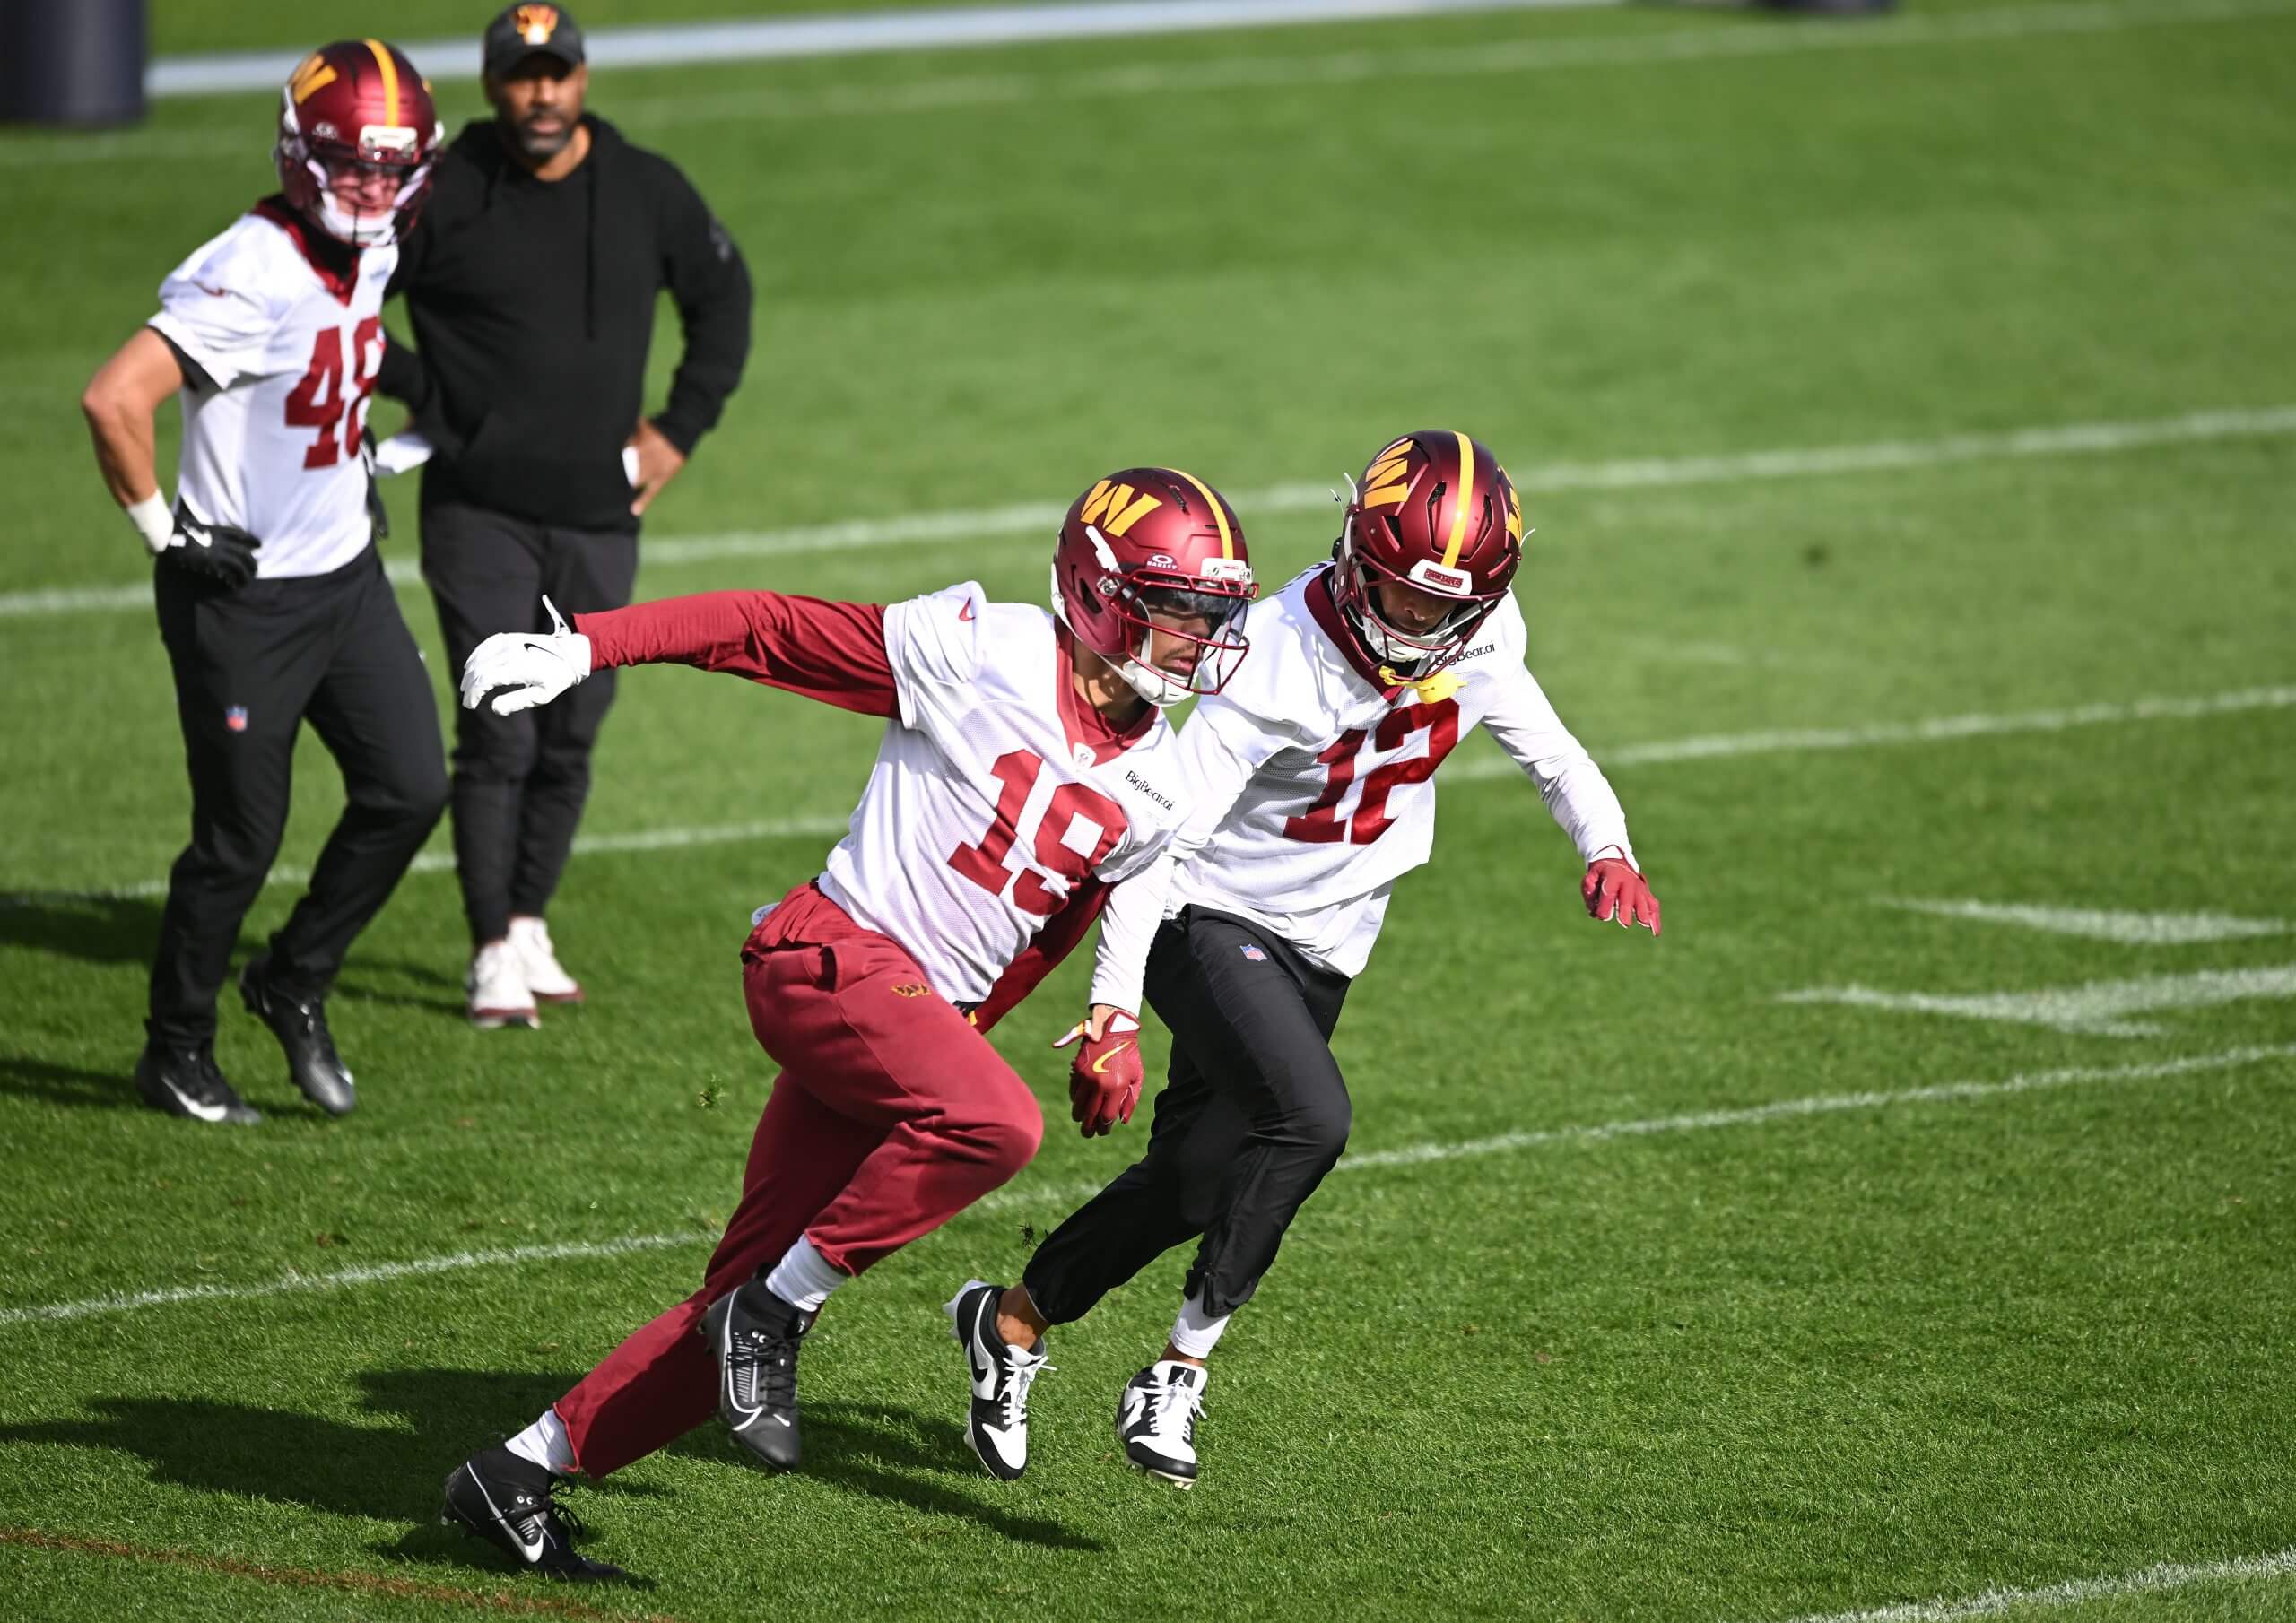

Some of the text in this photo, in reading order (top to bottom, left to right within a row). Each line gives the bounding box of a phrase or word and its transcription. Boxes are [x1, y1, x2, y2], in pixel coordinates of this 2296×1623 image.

[1080, 479, 1163, 537] W
[1364, 439, 1414, 510] W
[1126, 769, 1175, 811] BigBear.ai
[1283, 697, 1460, 845] 12
[947, 749, 1128, 916] 19
